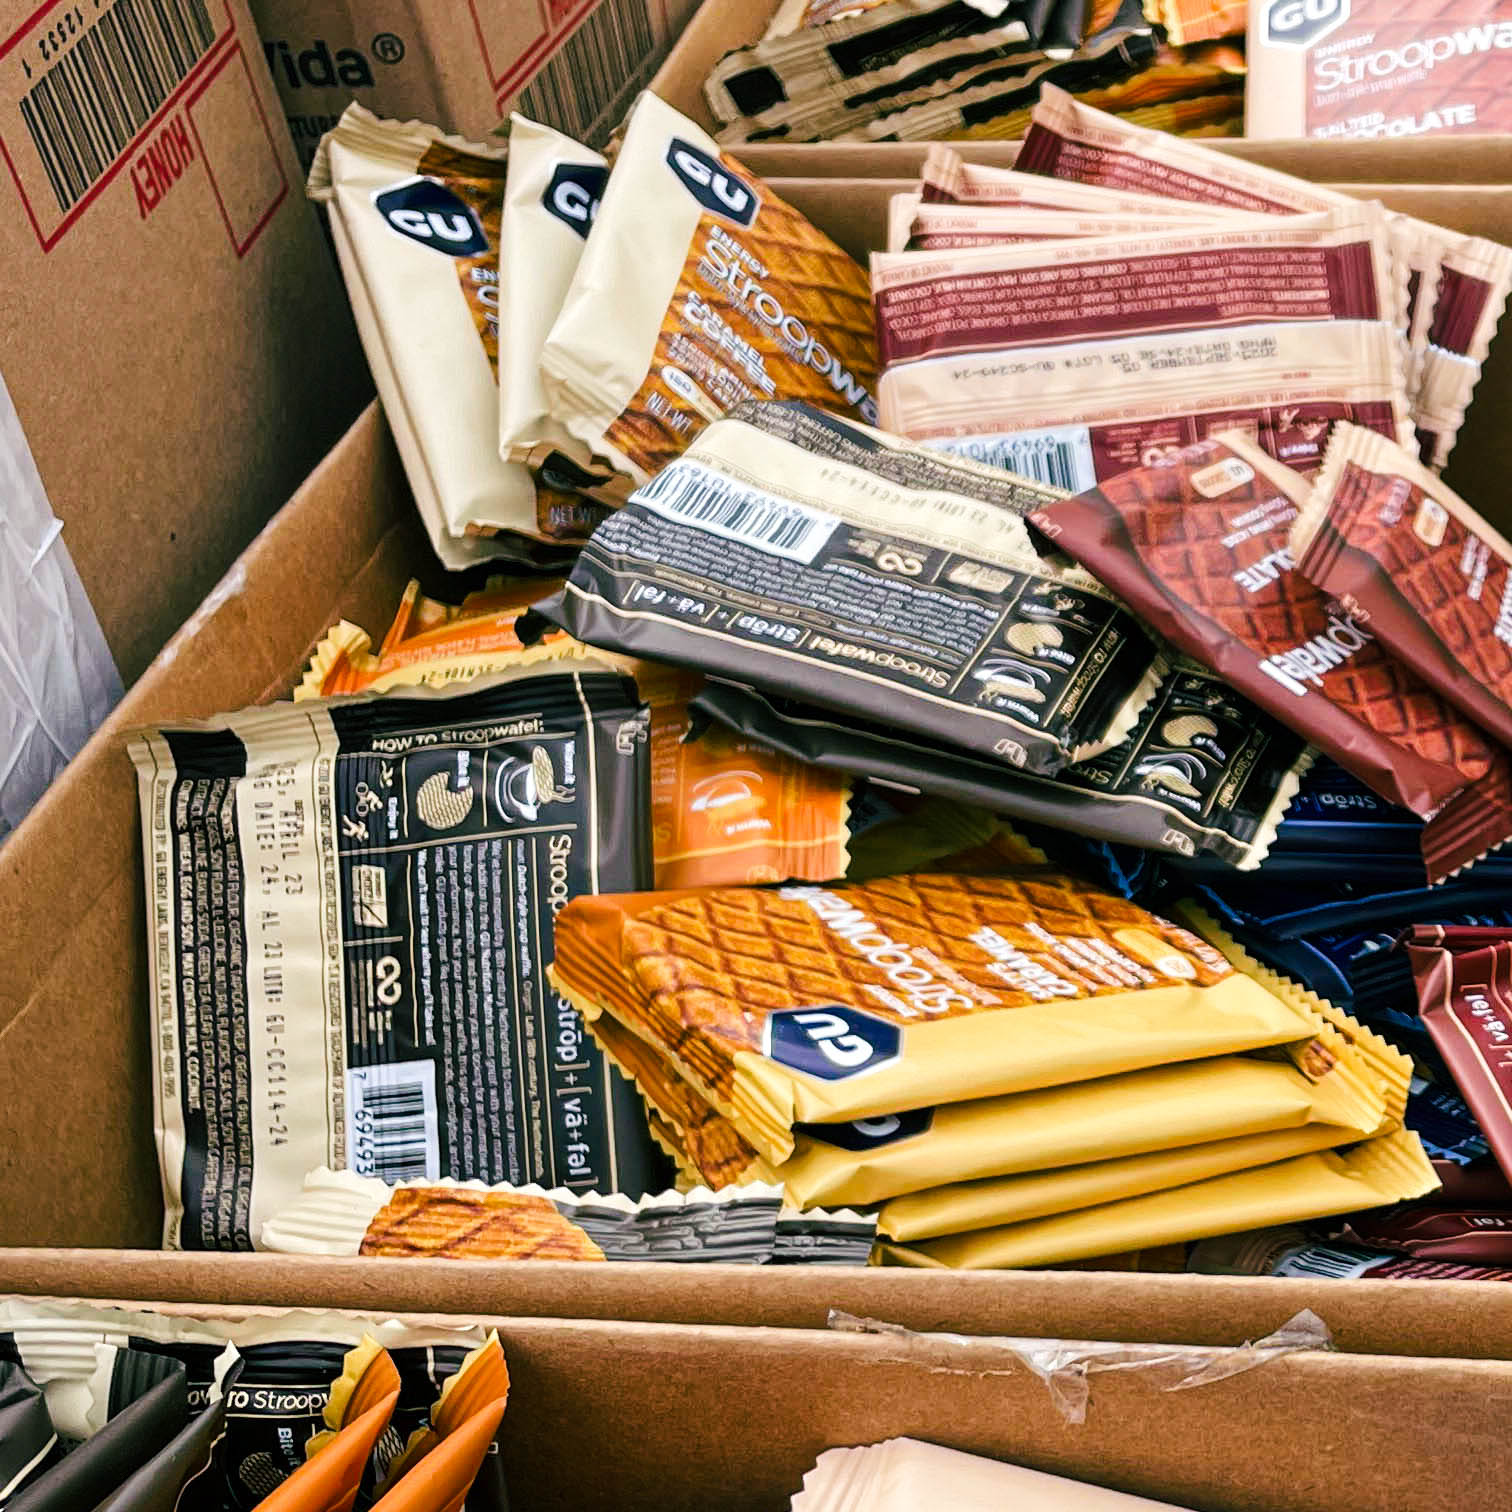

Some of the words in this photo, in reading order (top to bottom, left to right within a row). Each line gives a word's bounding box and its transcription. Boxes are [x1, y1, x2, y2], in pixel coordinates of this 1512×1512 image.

[130, 113, 194, 220] HONEY
[668, 146, 752, 214] GU
[388, 208, 475, 242] GU
[808, 629, 952, 691] Stroopwafel
[794, 1011, 875, 1069] GU
